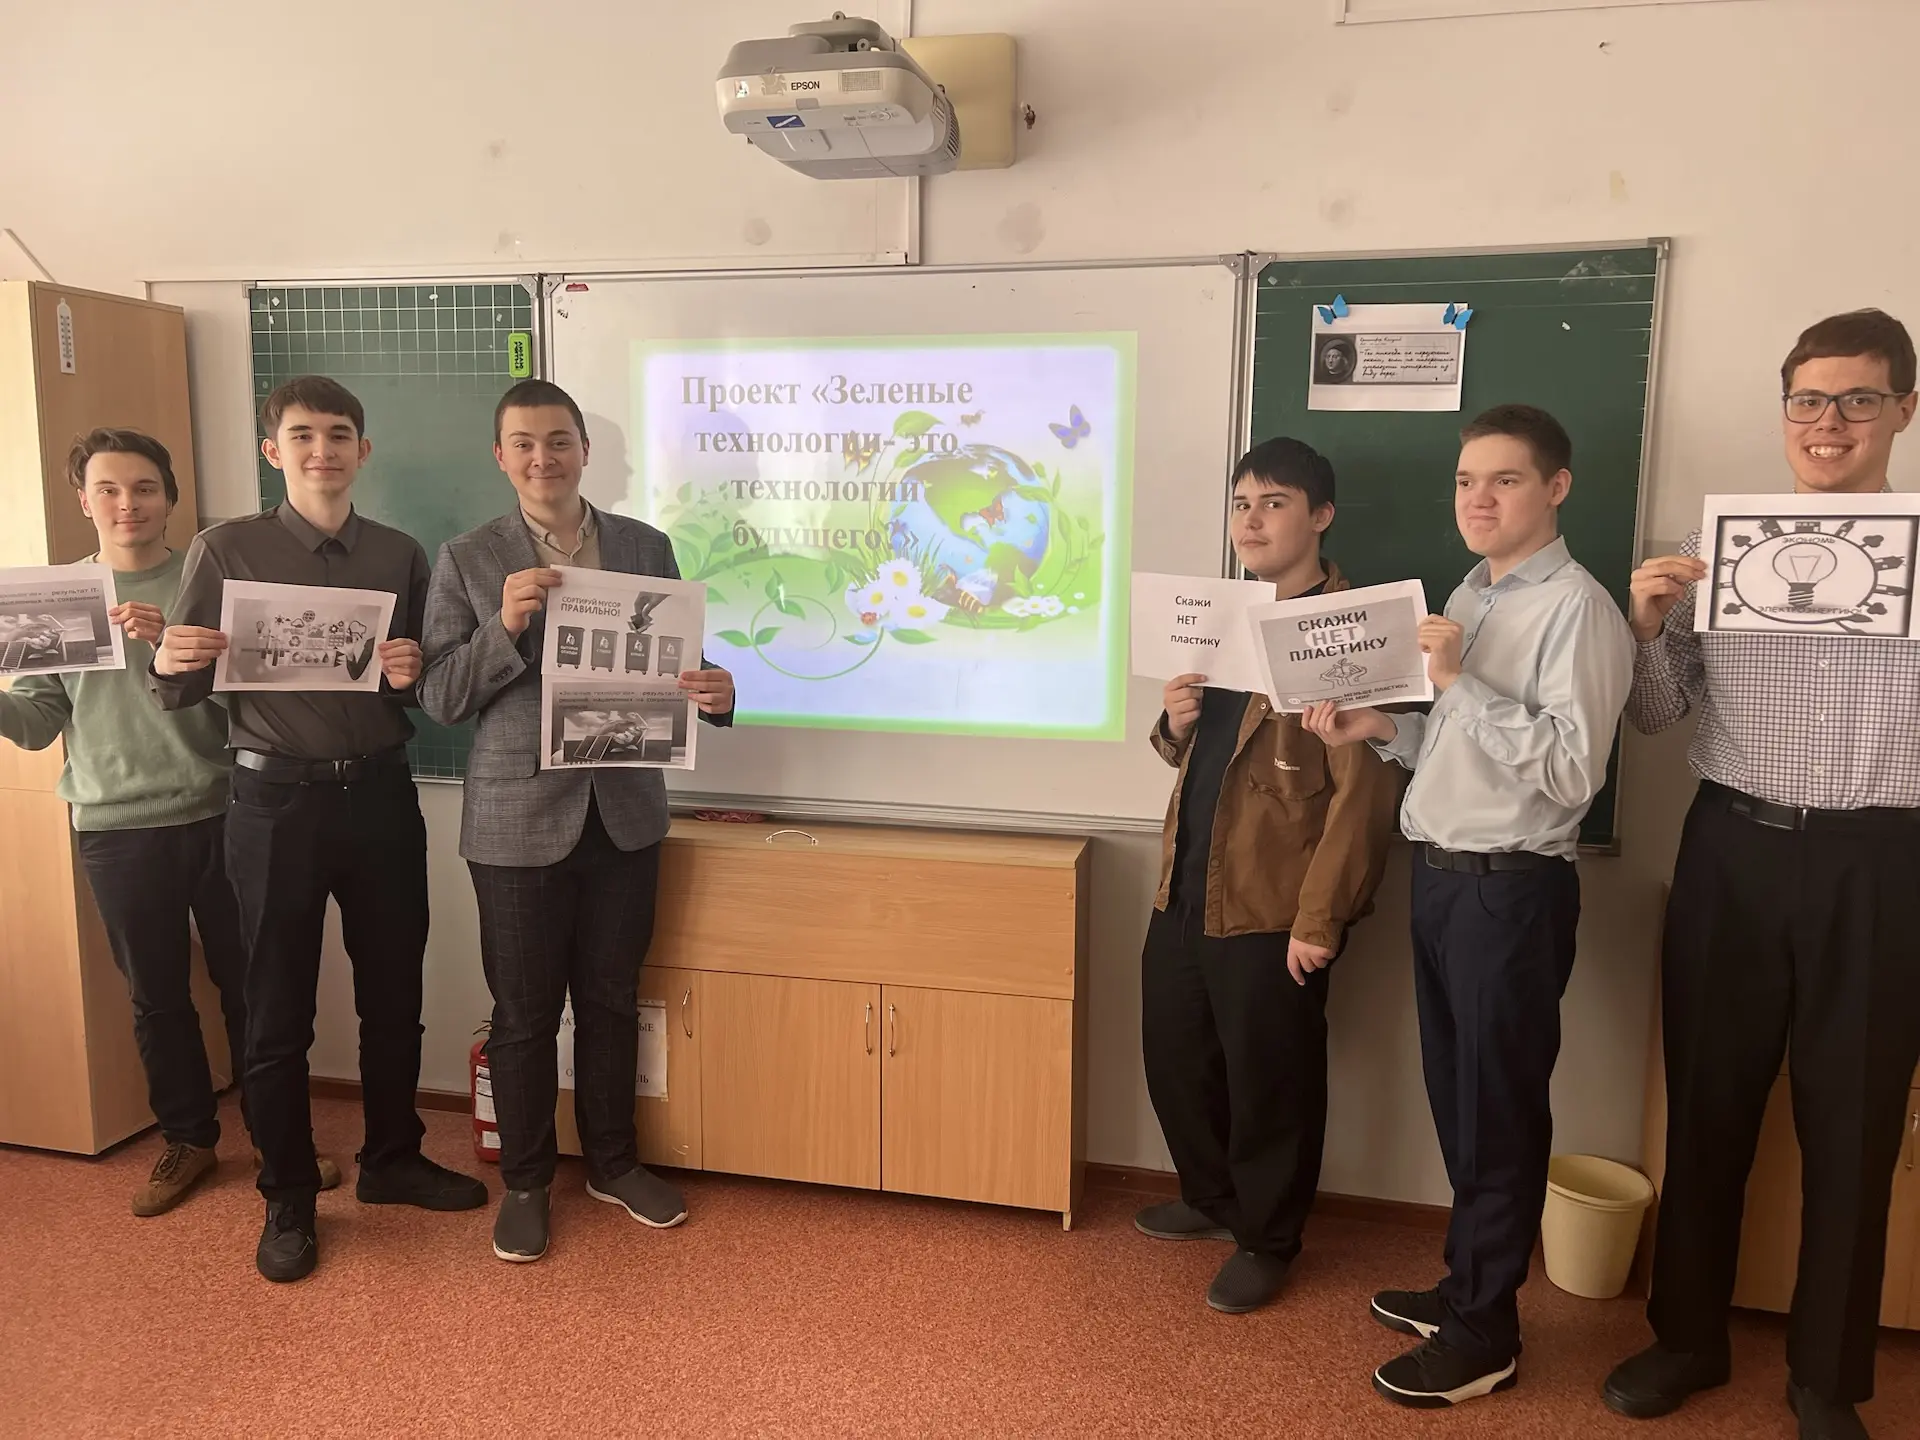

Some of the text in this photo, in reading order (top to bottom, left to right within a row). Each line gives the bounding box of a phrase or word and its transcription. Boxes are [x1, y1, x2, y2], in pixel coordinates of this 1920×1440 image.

[790, 80, 820, 91] EPSON
[681, 374, 974, 413] Проект «Зеленые
[694, 431, 959, 454] технологии- это
[730, 479, 920, 502] технологии
[1781, 536, 1836, 544] ЭКОНОМЬ
[598, 600, 622, 608] МУСОР
[1175, 595, 1211, 608] Скажи
[560, 603, 621, 617] ПРАВИЛЬНО!
[1177, 614, 1198, 625] НЕТ
[1297, 610, 1368, 632] СКАЖИ
[1170, 634, 1221, 648] пластику
[1311, 625, 1359, 647] НЕТ
[1289, 636, 1388, 662] ПЛАСТИКУ
